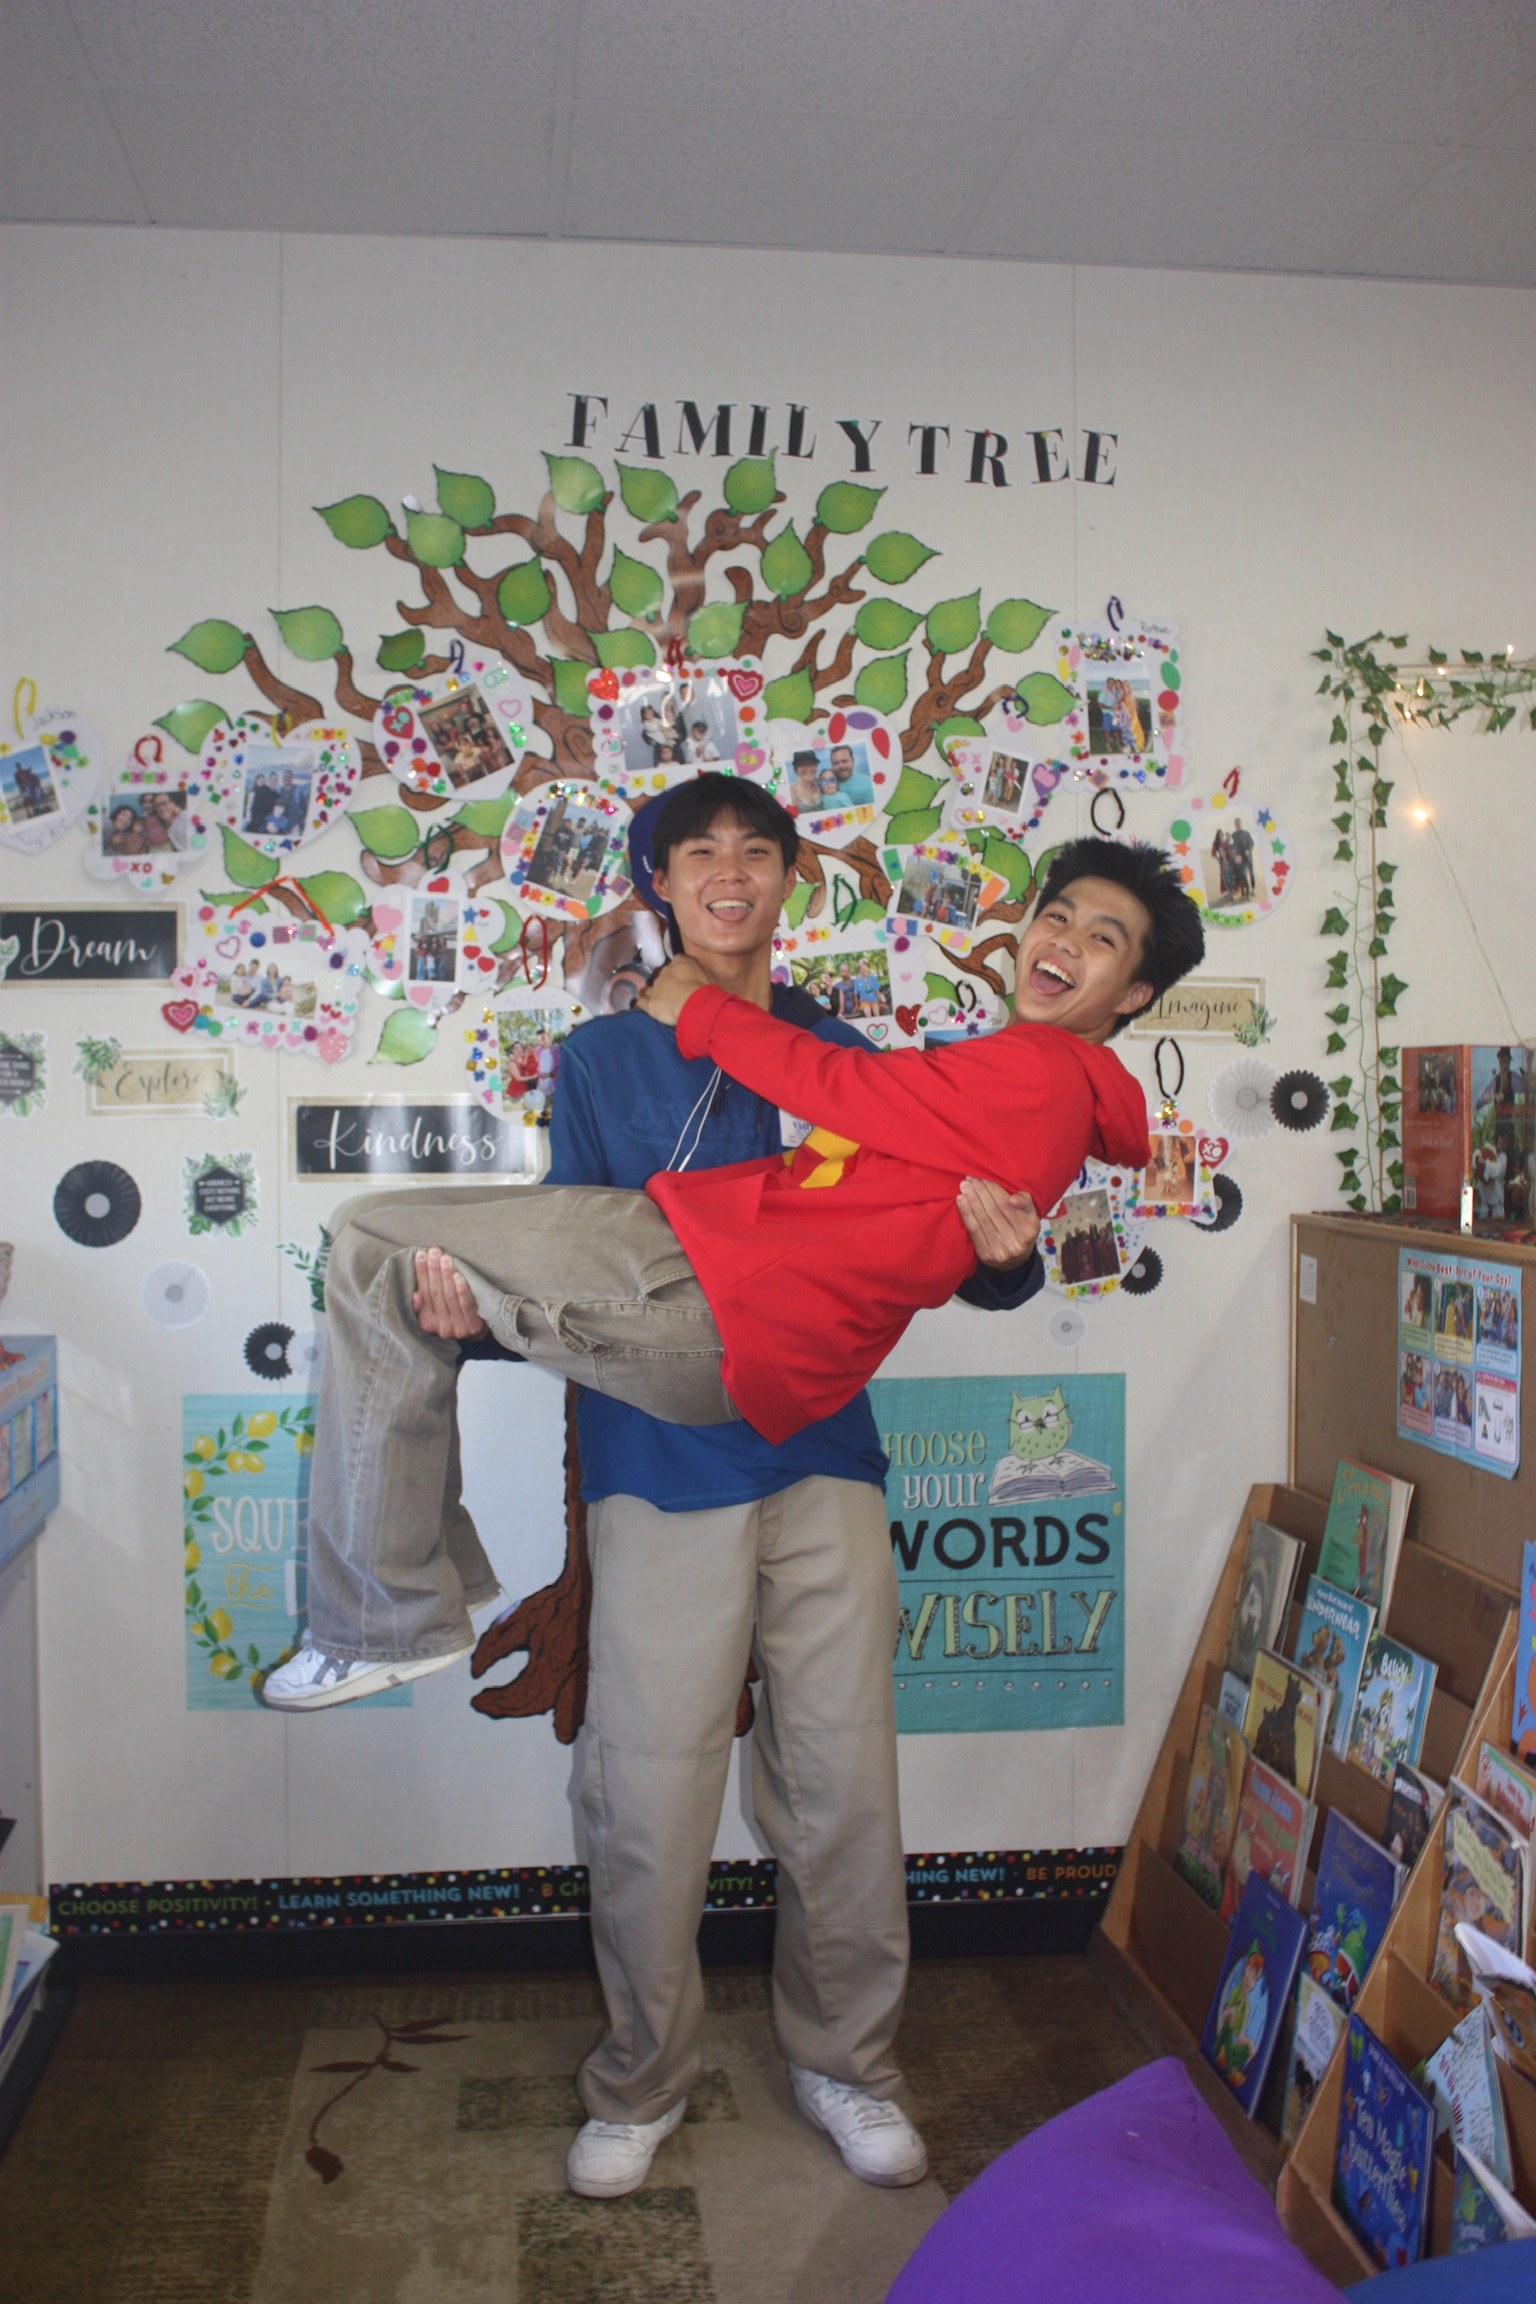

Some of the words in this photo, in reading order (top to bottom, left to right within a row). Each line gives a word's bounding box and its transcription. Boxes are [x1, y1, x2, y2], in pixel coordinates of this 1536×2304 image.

[564, 393, 882, 473] FAMILY
[909, 422, 1118, 487] TREE
[20, 916, 157, 975] Dream
[1150, 994, 1241, 1030] Imagine
[314, 1110, 503, 1170] Kindness
[883, 1430, 987, 1467] HOOSE
[902, 1471, 986, 1510] your
[890, 1513, 1110, 1571] WORDS
[226, 1563, 275, 1600] the
[894, 1589, 1117, 1661] WISELY
[905, 1869, 950, 1884] HING
[955, 1867, 1005, 1882] NEW!
[1026, 1867, 1048, 1882] BE
[1055, 1864, 1118, 1881] PROUD
[58, 1900, 140, 1916] CHOOSE
[147, 1897, 258, 1913] POSITIVITY!
[279, 1894, 341, 1910] LEARN
[347, 1888, 462, 1908] SOMETHING
[468, 1884, 521, 1901] NEW!
